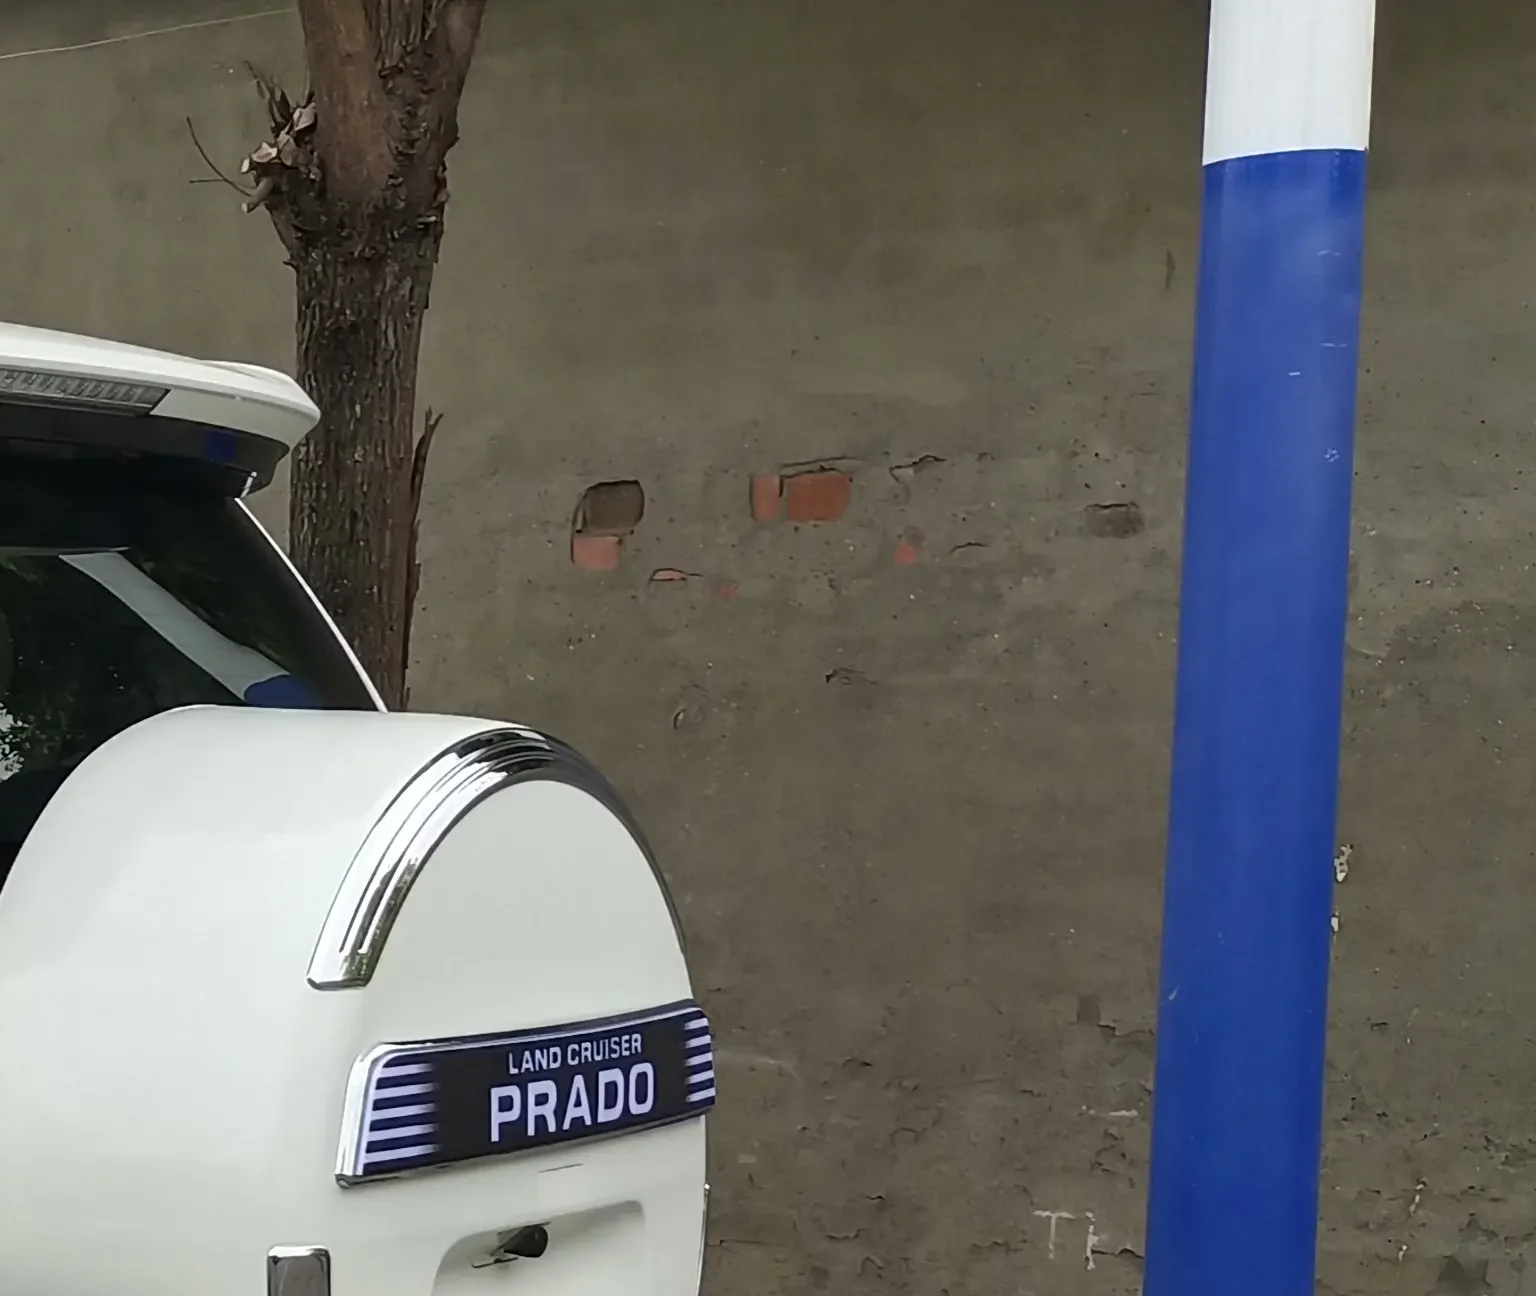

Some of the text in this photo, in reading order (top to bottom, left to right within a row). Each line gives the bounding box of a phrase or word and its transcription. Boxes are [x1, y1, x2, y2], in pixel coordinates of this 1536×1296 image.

[509, 1033, 642, 1075] LAND CRUISER
[489, 1062, 655, 1143] PRADO
